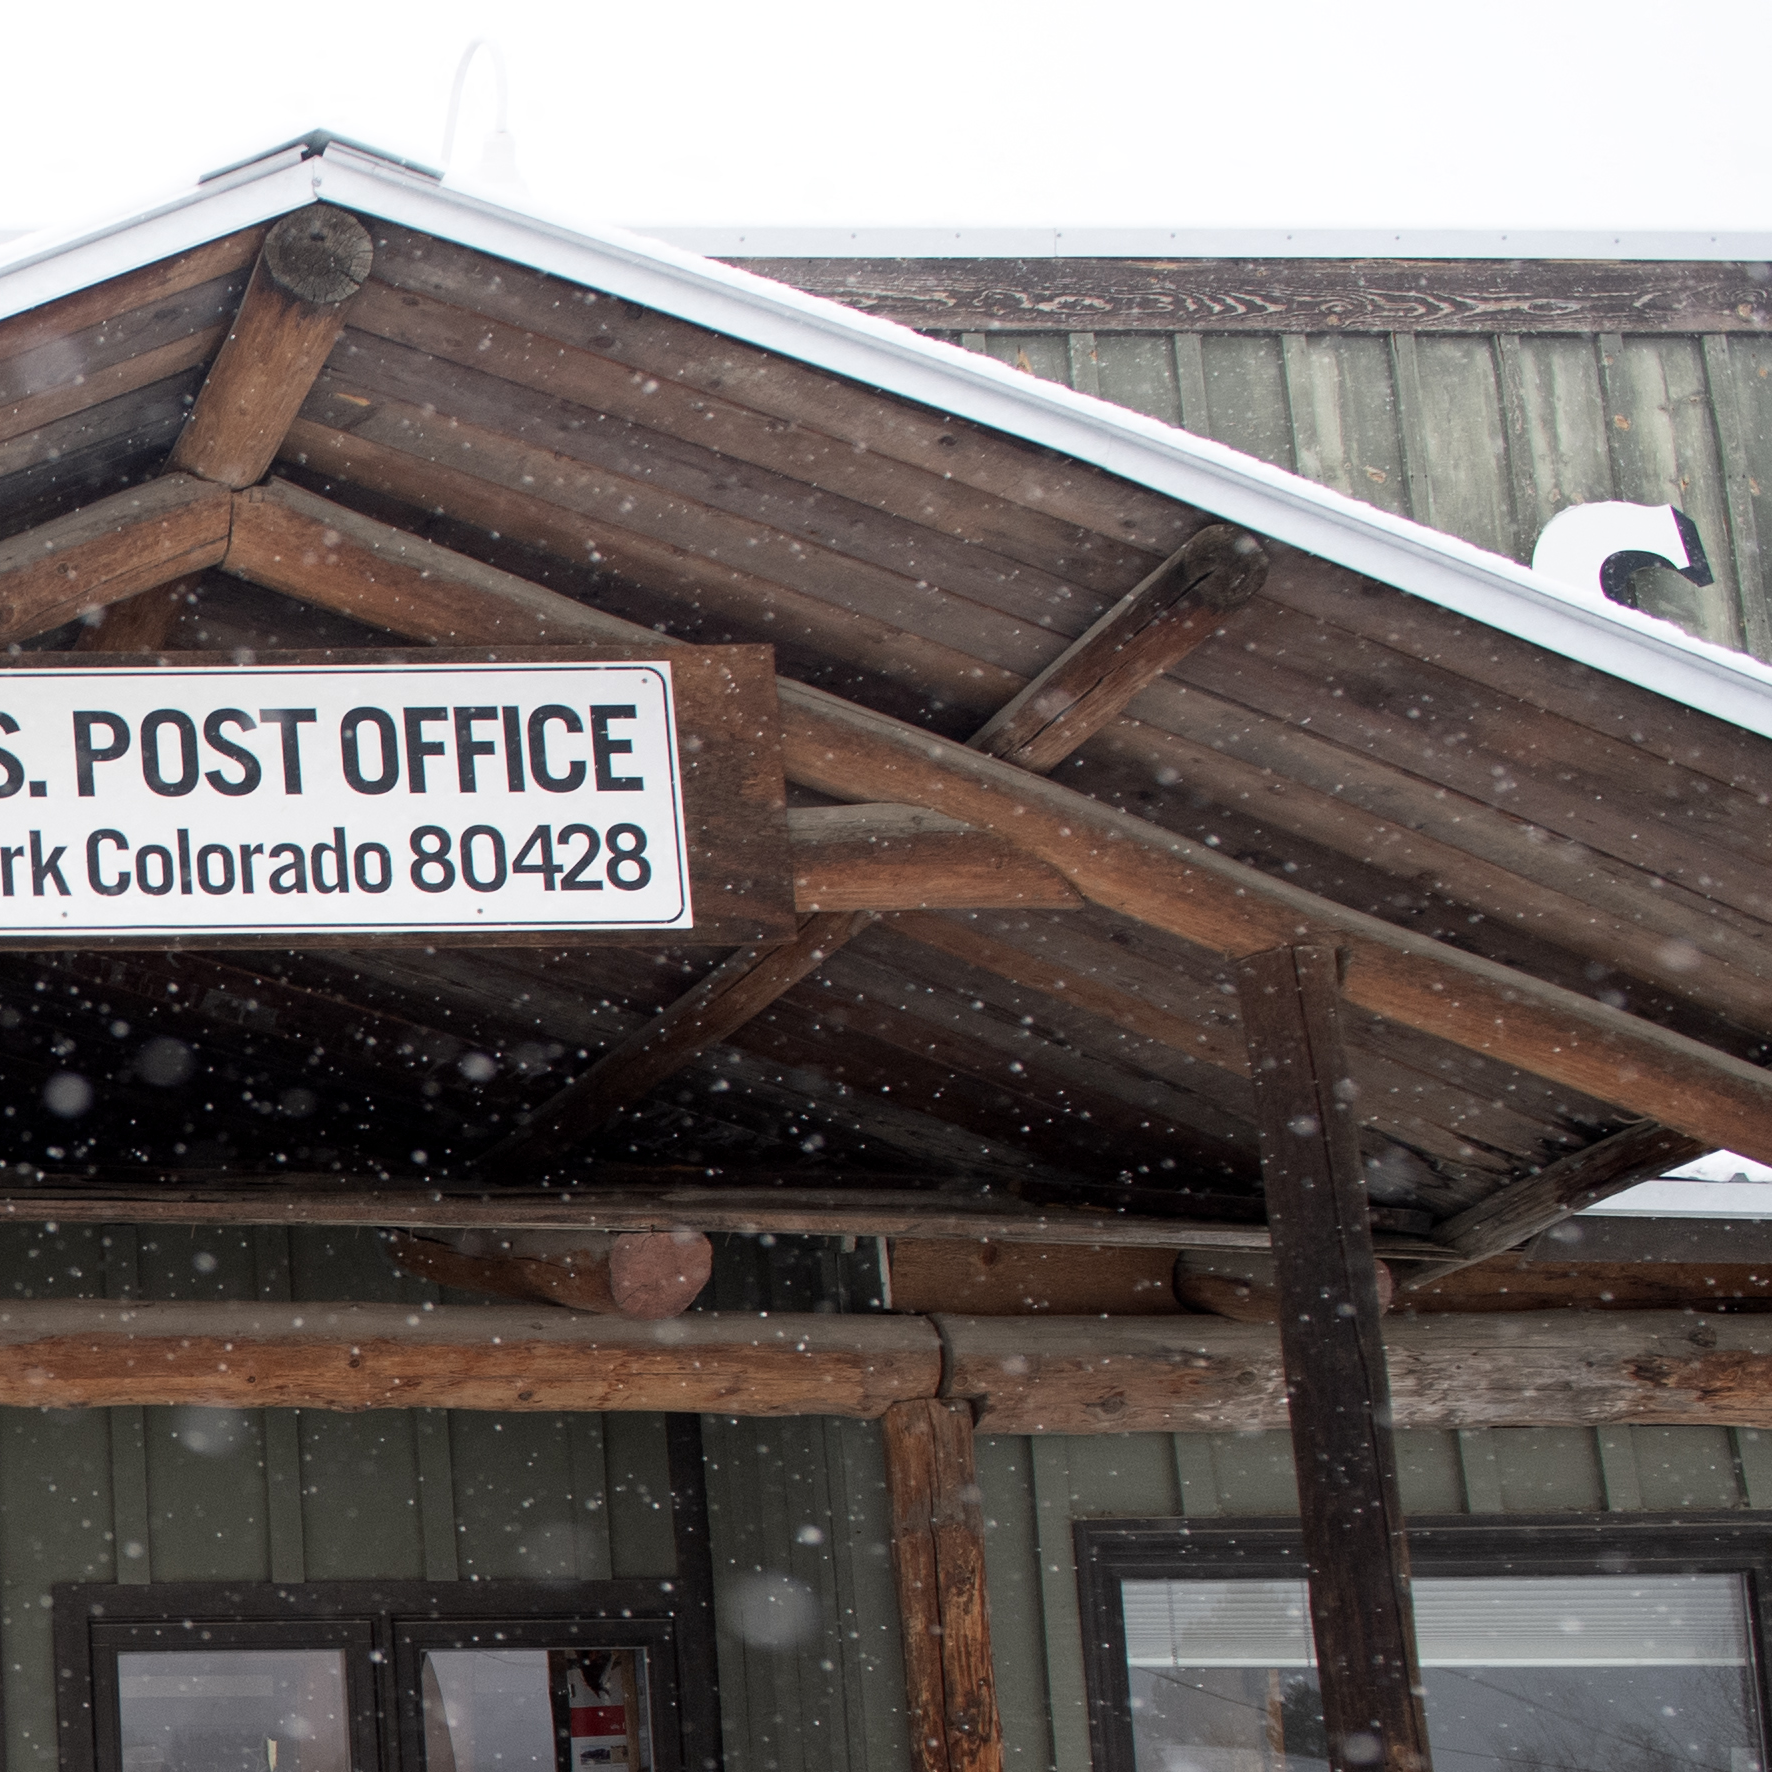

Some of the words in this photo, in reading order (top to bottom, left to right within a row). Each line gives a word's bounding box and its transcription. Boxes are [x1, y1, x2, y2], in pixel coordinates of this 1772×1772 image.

[73, 708, 317, 797] POST
[340, 703, 645, 795] OFFICE
[85, 825, 392, 897] Colorado
[409, 822, 652, 893] 80428
